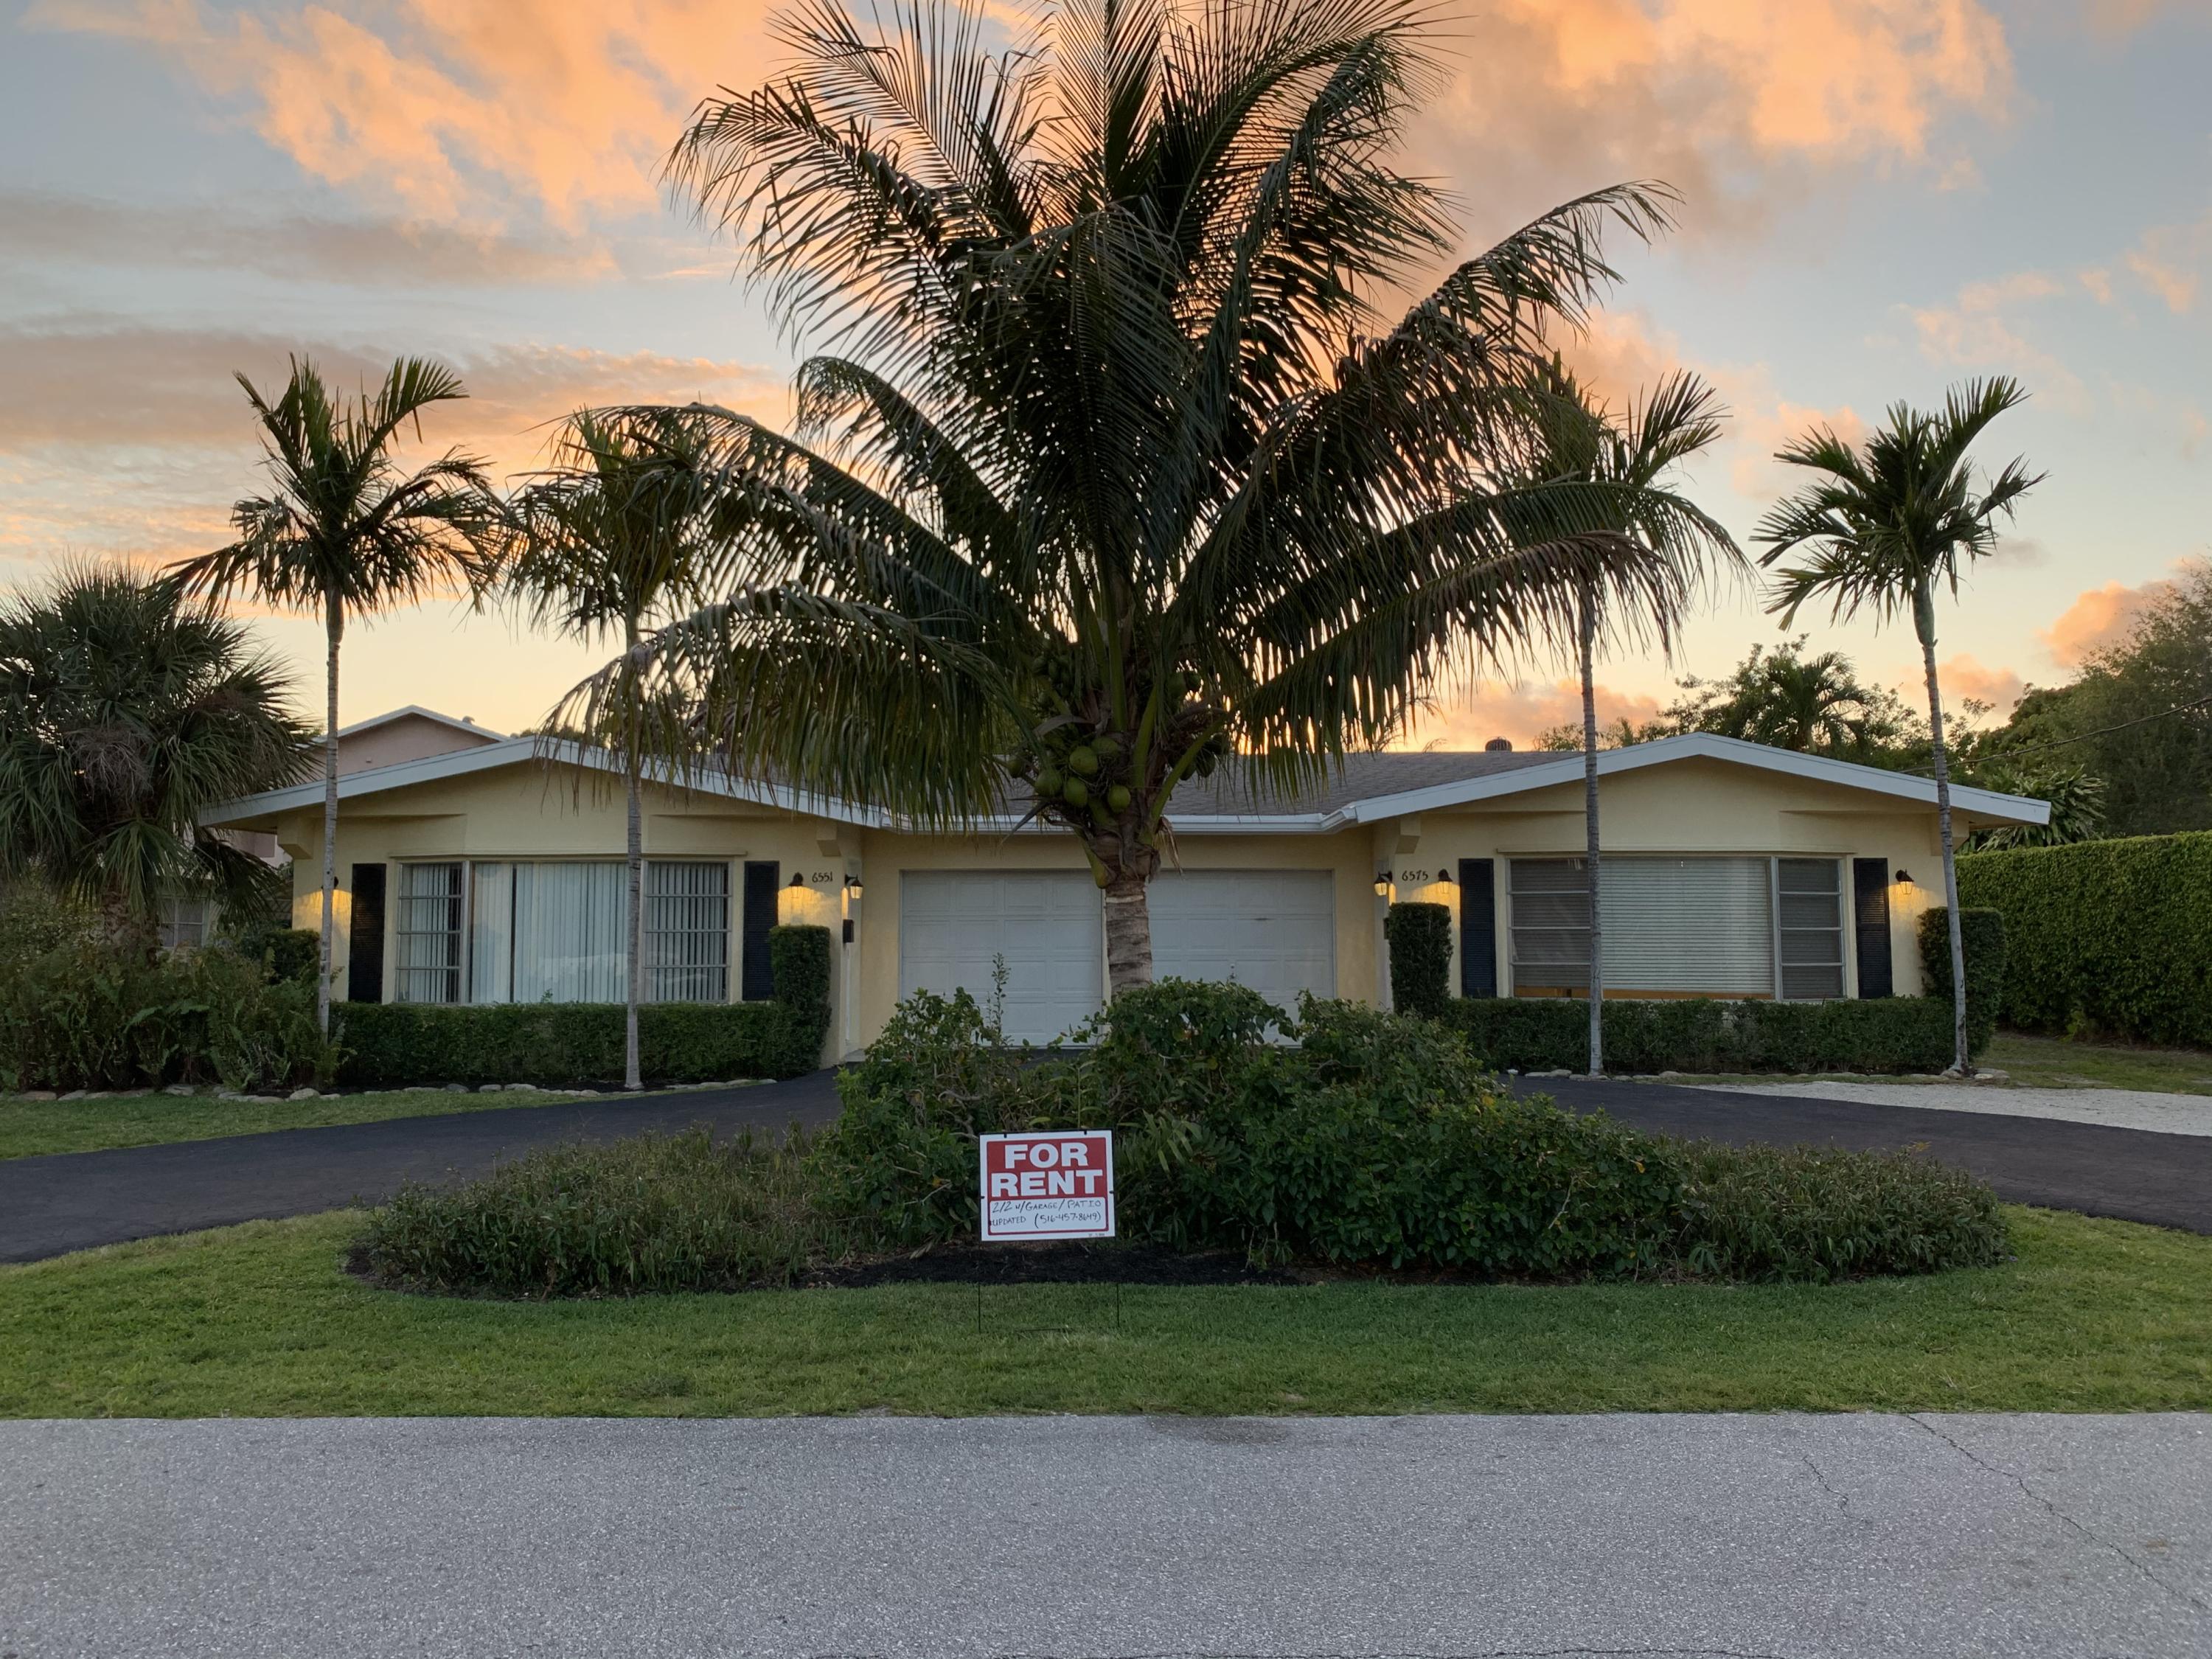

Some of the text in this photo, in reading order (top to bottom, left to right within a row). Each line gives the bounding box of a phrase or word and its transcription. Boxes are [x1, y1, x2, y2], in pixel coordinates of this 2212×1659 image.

[812, 872, 833, 883] 6551
[1402, 870, 1428, 881] 6575
[1005, 1142, 1088, 1169] FOR
[991, 1169, 1103, 1197] RENT
[992, 1201, 1012, 1213] 2/2
[992, 1216, 1026, 1226] UPDATED
